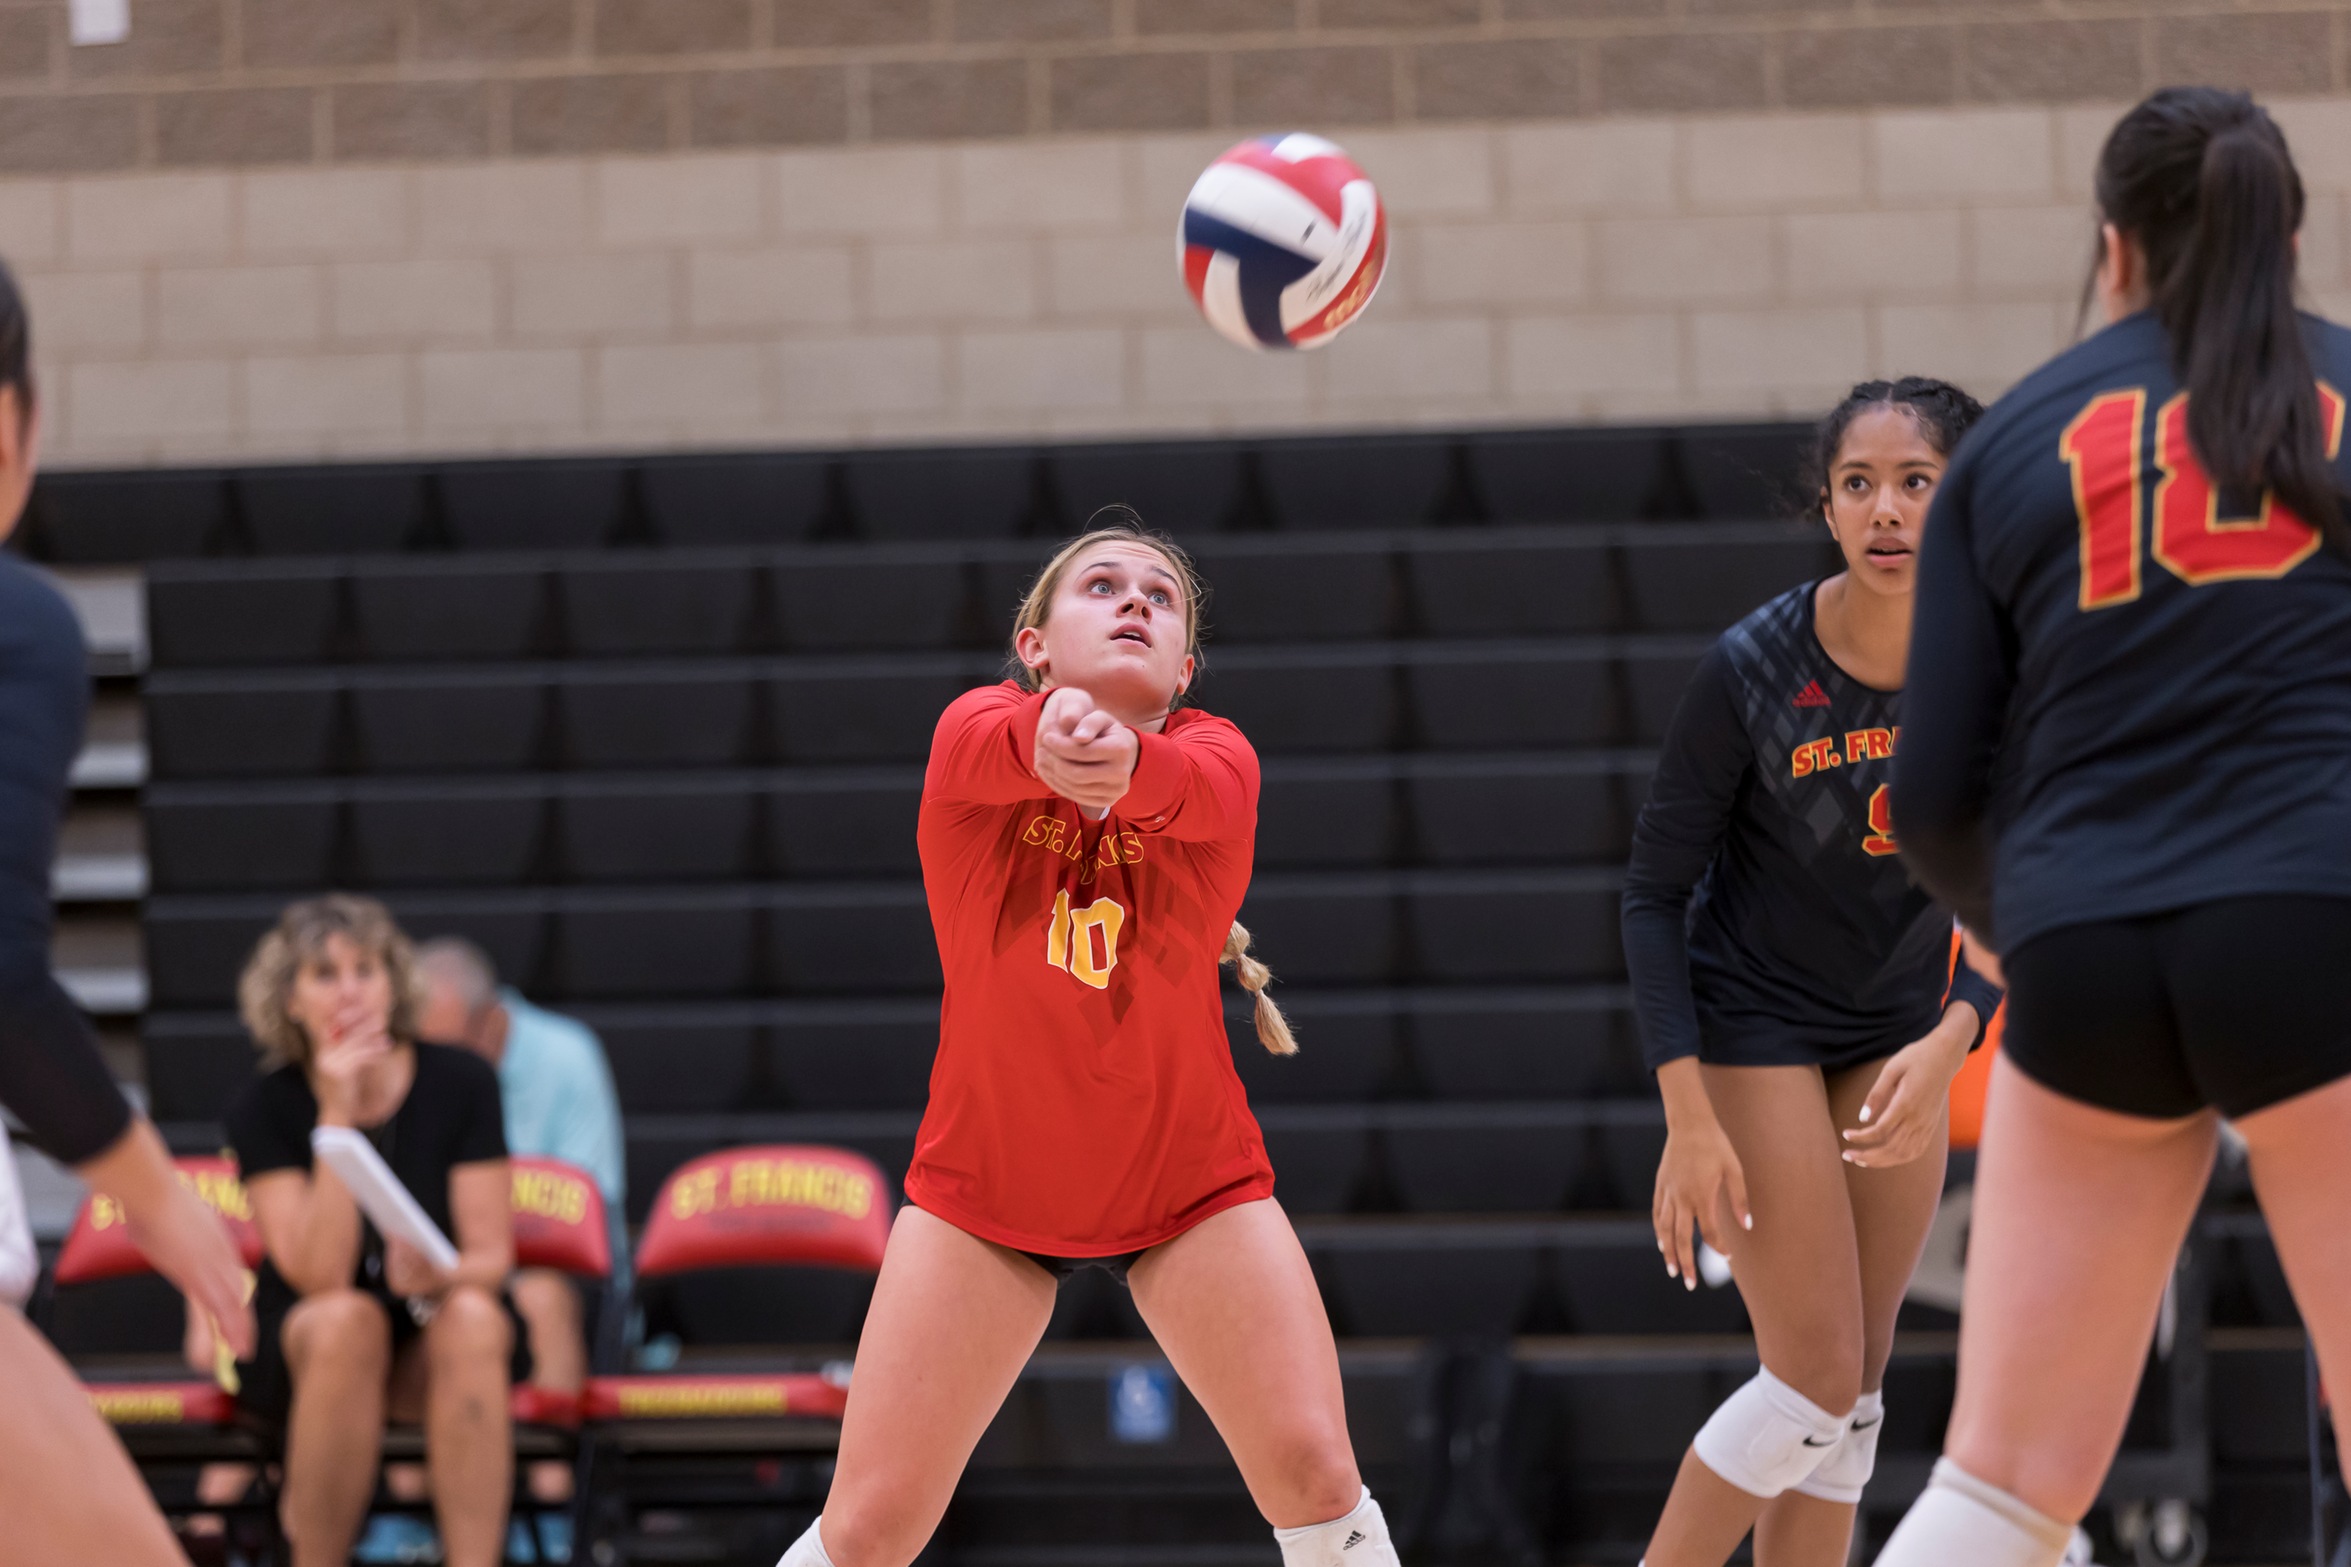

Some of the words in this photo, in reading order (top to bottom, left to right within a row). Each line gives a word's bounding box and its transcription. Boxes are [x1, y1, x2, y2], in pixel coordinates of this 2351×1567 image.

[2058, 379, 2346, 612] 18
[1791, 736, 1842, 779] ST.
[1022, 815, 1066, 853] ST.
[1047, 887, 1125, 989] 10
